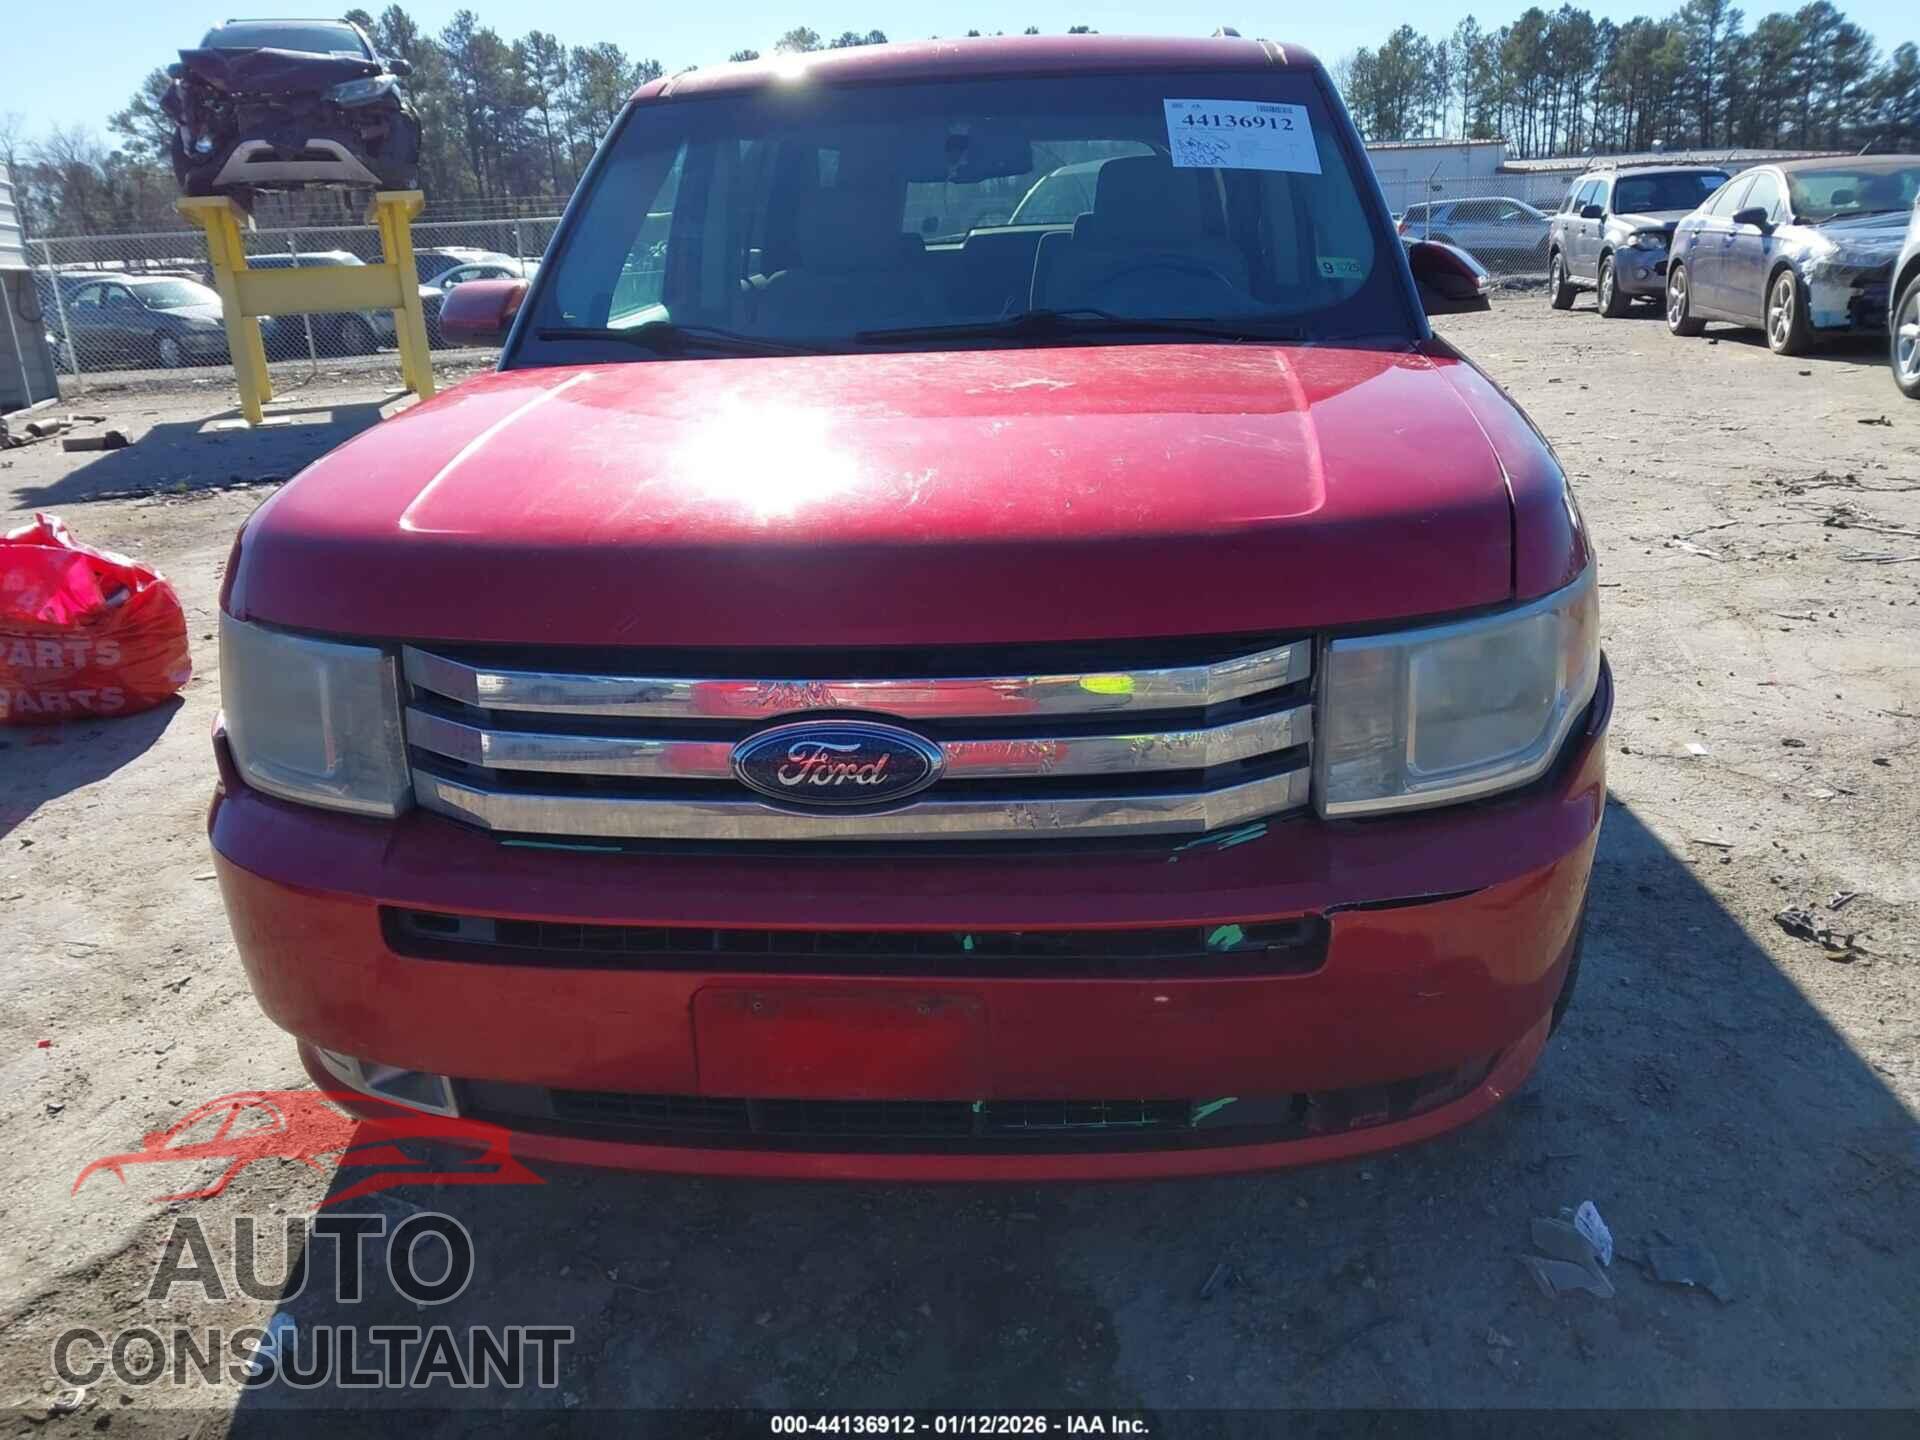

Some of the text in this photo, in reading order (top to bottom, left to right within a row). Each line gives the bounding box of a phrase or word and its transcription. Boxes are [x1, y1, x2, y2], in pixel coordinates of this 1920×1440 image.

[1182, 113, 1294, 132] 44136912
[0, 639, 121, 668] ARTS
[778, 740, 890, 786] Ford
